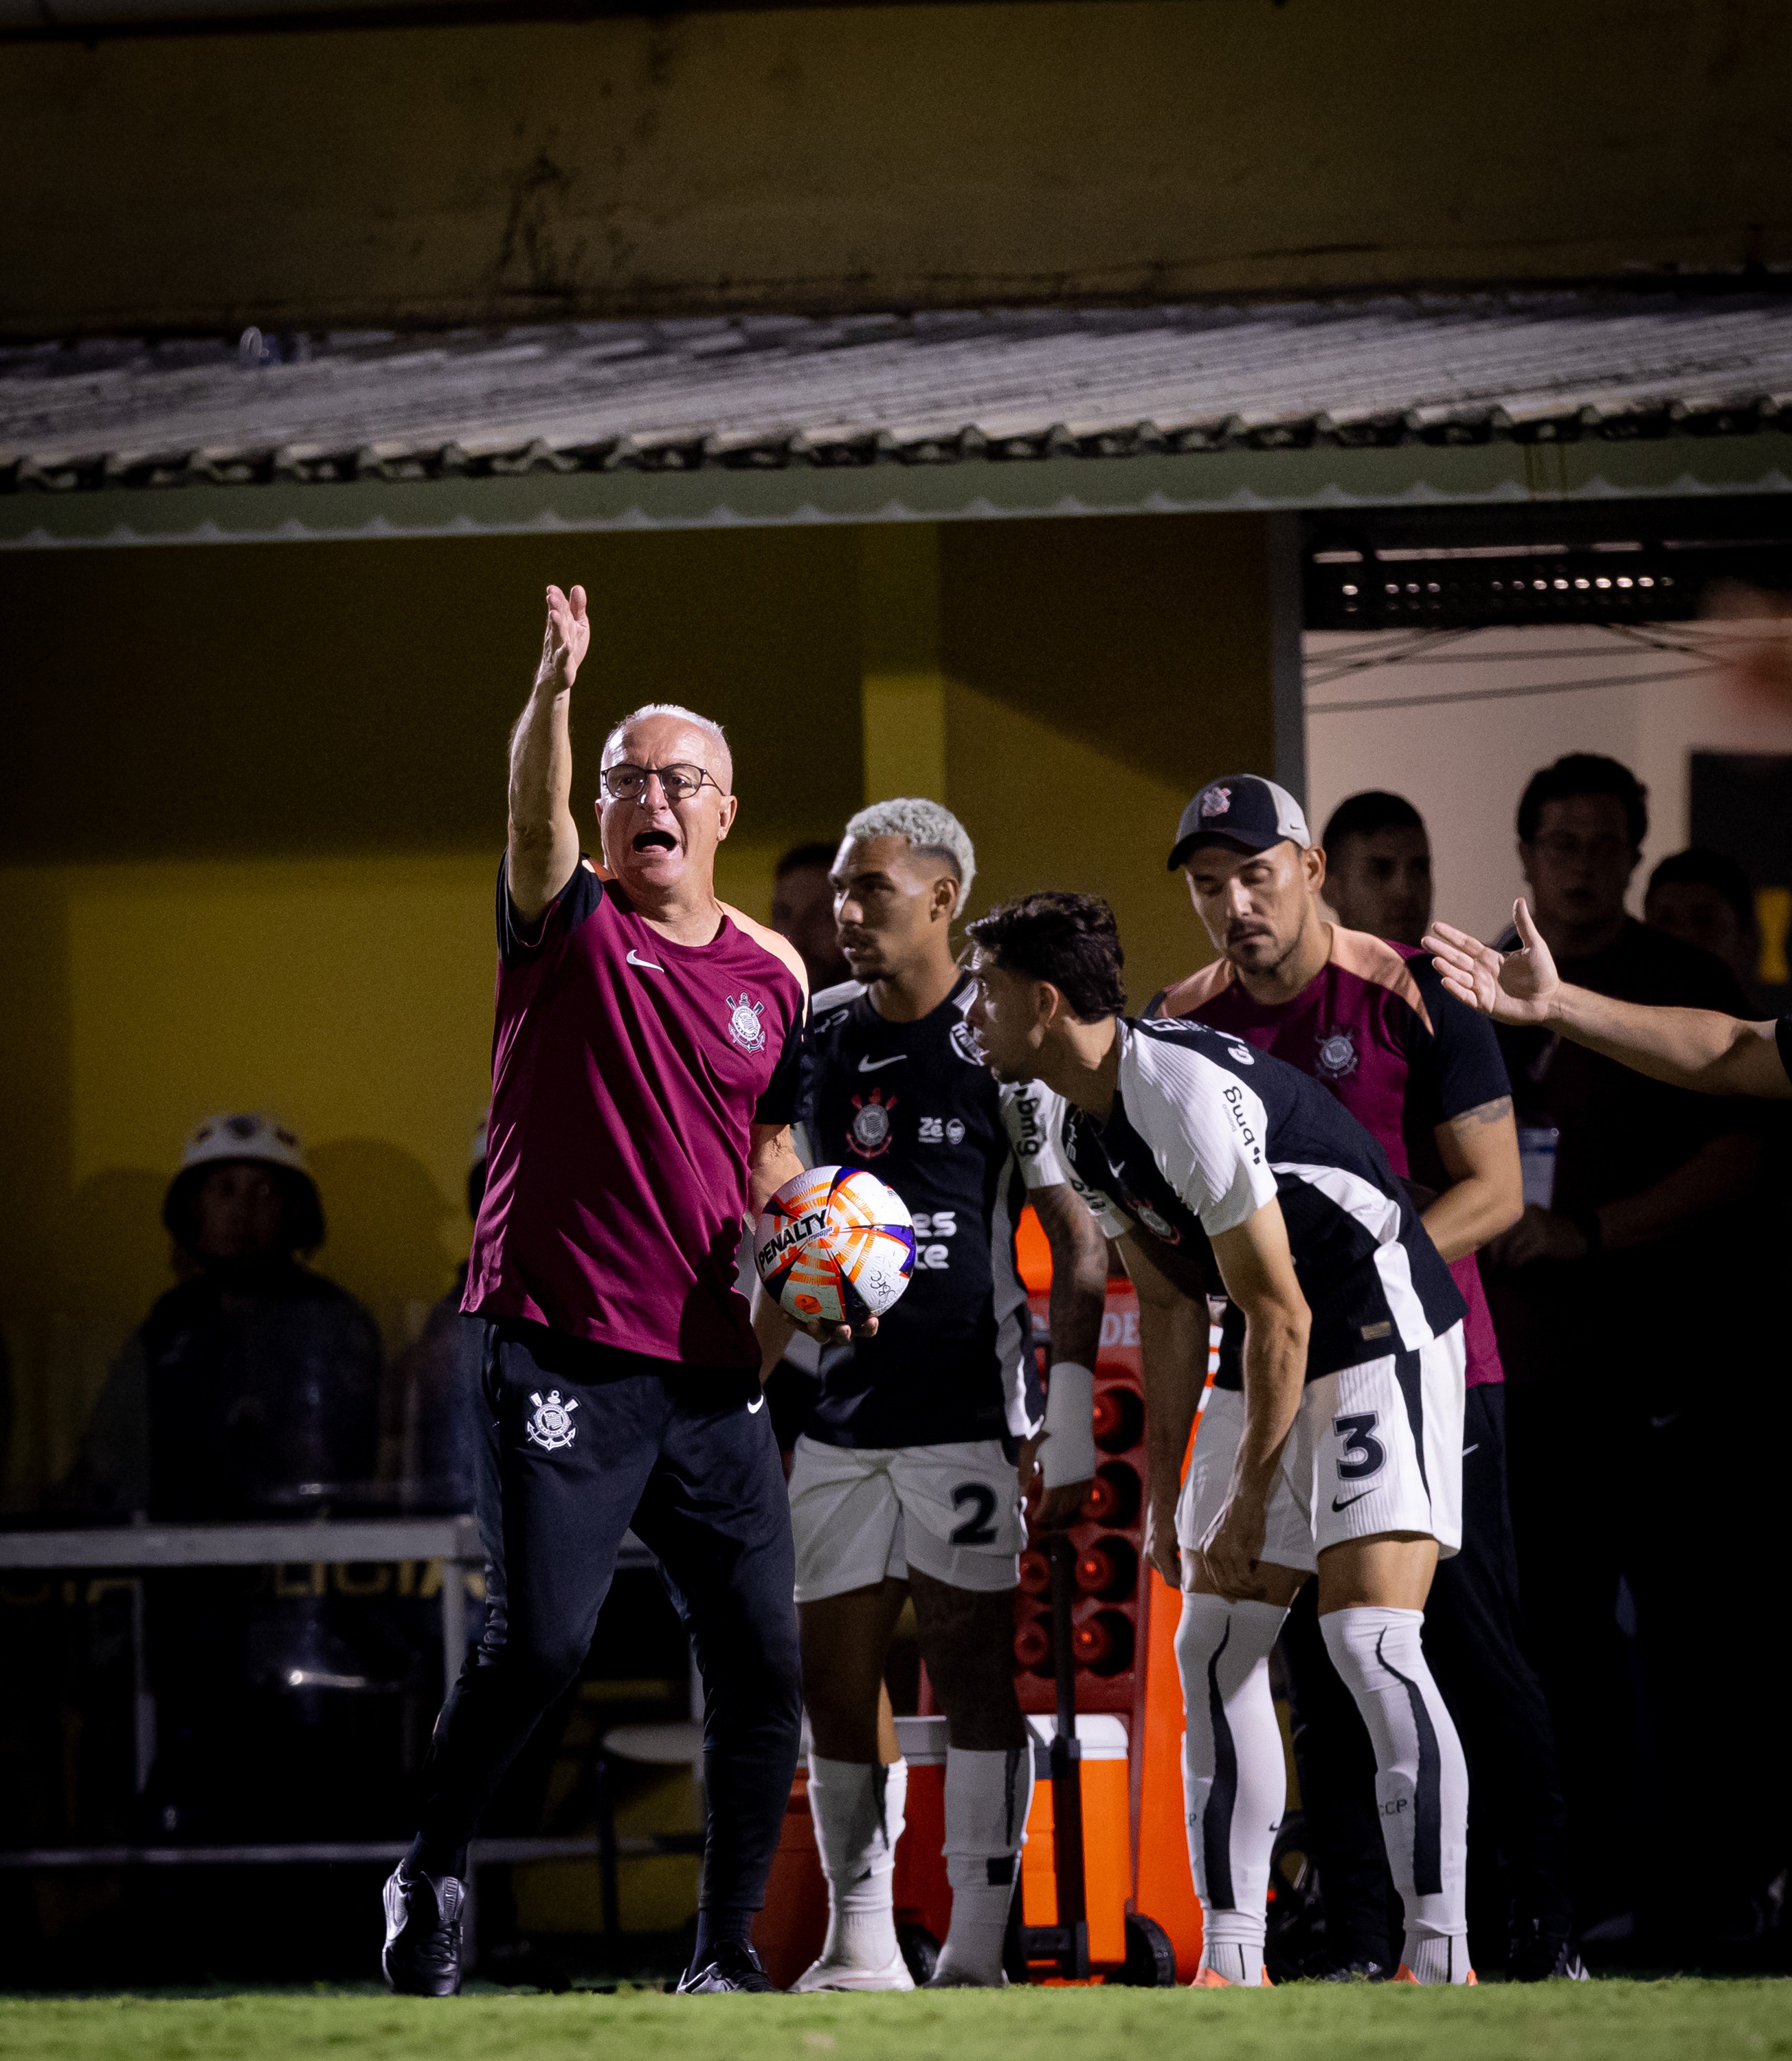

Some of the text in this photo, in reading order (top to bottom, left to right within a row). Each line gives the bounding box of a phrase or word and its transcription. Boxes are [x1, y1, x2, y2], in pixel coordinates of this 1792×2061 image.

[1017, 1097, 1040, 1156] bmg
[1223, 1086, 1255, 1146] bmg
[758, 1208, 827, 1269] PENALTY
[1333, 1411, 1386, 1481] 3
[950, 1483, 998, 1545] 2
